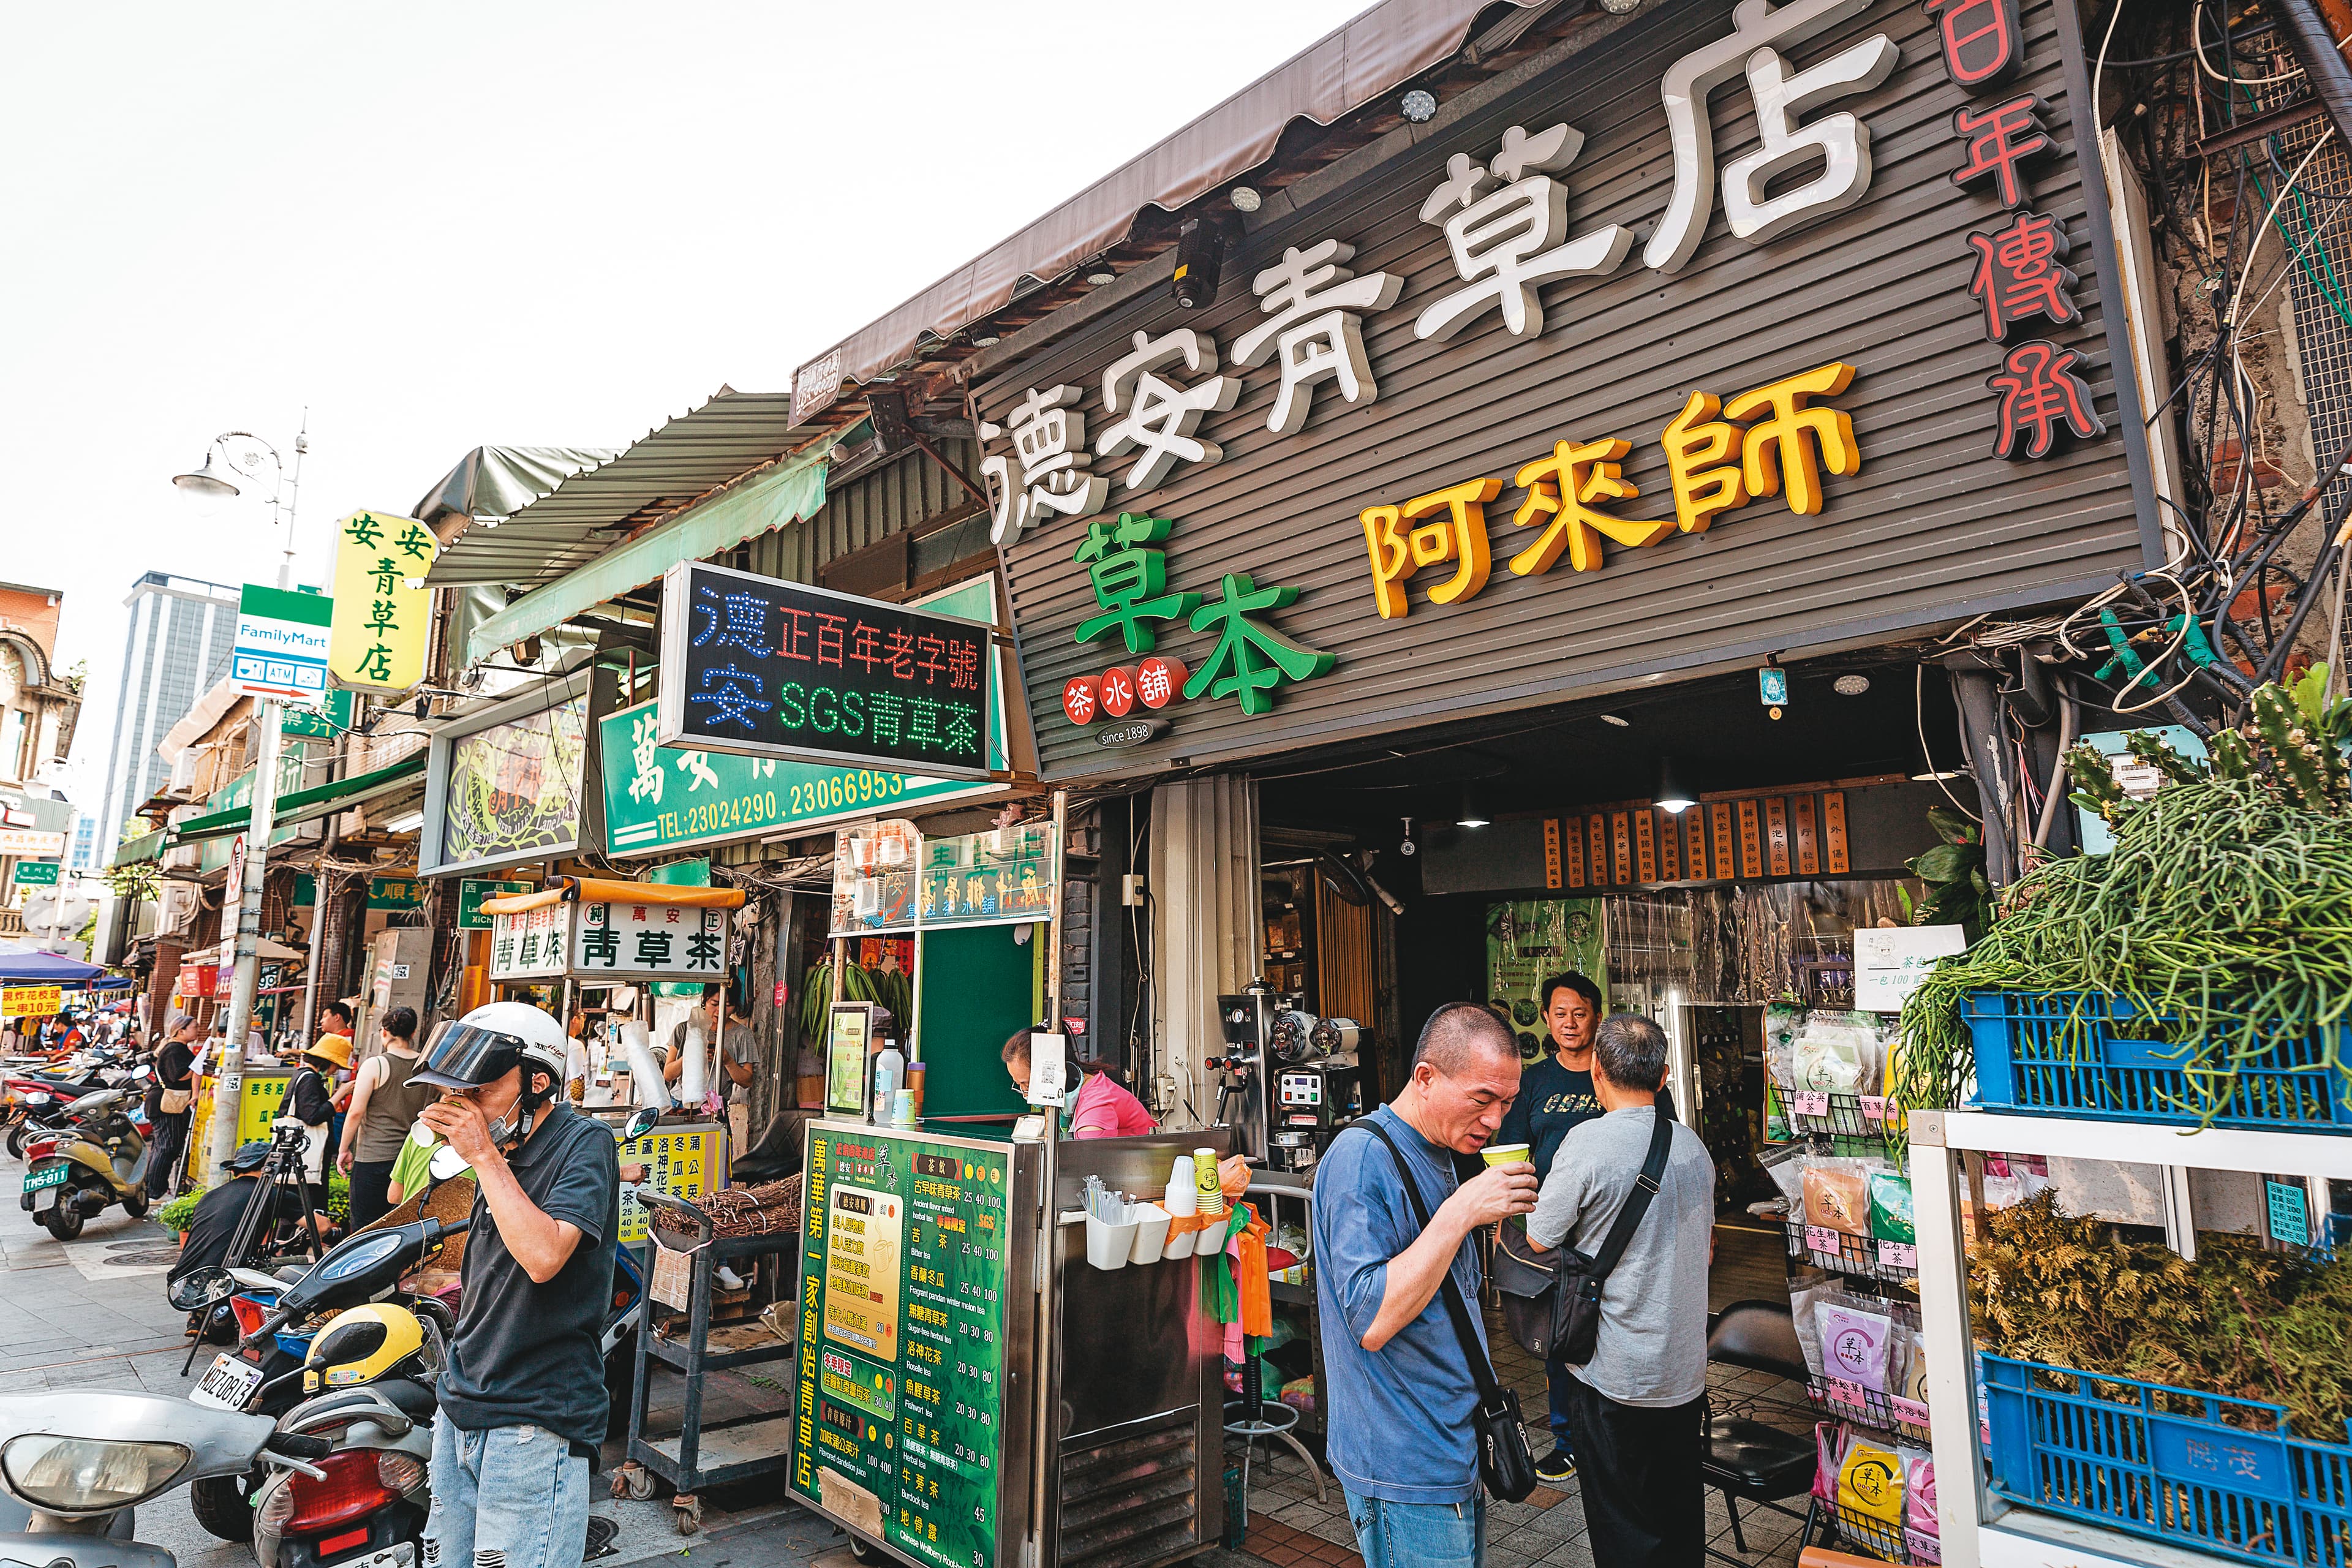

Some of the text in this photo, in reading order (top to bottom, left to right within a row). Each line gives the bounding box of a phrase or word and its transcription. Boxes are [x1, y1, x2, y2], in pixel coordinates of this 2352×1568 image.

[1923, 0, 2098, 457] 百年傳承
[979, 0, 1900, 545] 德安青草店
[1360, 361, 1861, 617] 阿來師
[355, 557, 405, 681] 青草店
[1073, 512, 1335, 715] 草本
[241, 624, 326, 647] FamilyMart
[691, 585, 774, 729] 德安
[776, 606, 978, 691] 正百年老字號
[270, 668, 291, 679] ATM
[779, 681, 978, 755] SGS青草茶
[1102, 725, 1148, 745] since 1898
[632, 906, 680, 924] 萬安
[706, 913, 718, 927] 正
[496, 929, 566, 972] 青草茶
[582, 928, 722, 970] 青草茶
[1891, 974, 1909, 985] 100
[2, 989, 60, 1001] 現炸花枝球
[4, 1001, 56, 1013] 一串10元
[1795, 1090, 1825, 1101] 蒲公英
[1806, 1103, 1815, 1114] 茶
[1862, 1101, 1896, 1114] 百草茶
[875, 1144, 898, 1191] 草本
[928, 1158, 946, 1175] 茶飲
[914, 1179, 1001, 1209] 古早味青草茶 25 40 100
[2284, 1188, 2299, 1197] 100
[2286, 1197, 2296, 1205] 80
[912, 1211, 925, 1221] herbal
[913, 1199, 955, 1215] Ancient flavor mixed
[2286, 1205, 2302, 1214] 100
[978, 1213, 994, 1229] SGS
[2288, 1215, 2302, 1223] 100
[620, 1229, 631, 1237] 100
[1805, 1226, 1838, 1241] 花生根
[2296, 1233, 2306, 1242] 80
[911, 1246, 923, 1257] Bitter
[962, 1242, 971, 1254] 25
[973, 1245, 982, 1257] 40
[985, 1248, 998, 1262] 100
[1818, 1239, 1828, 1251] 茶
[1891, 1253, 1903, 1265] 茶
[910, 1264, 997, 1302] 香蘭冬瓜 25 40 100
[909, 1284, 986, 1315] Fragrant pandan winter melon tea
[797, 1138, 827, 1490] 萬華第一家創始青草店
[908, 1302, 993, 1343] 無糖青草茶 20 30 80
[876, 1322, 884, 1333] 80
[907, 1322, 930, 1337] Sugar-free
[930, 1330, 944, 1342] herbal
[907, 1339, 992, 1384] 洛神花茶 20 30 80
[1841, 1336, 1865, 1366] 草本
[823, 1352, 852, 1378] 冬季限定
[906, 1360, 932, 1378] Roselle tea
[874, 1396, 892, 1412] 30 40
[904, 1399, 924, 1415] Fishwort
[905, 1378, 990, 1426] 魚腥草茶 20 30 80
[1841, 1391, 1852, 1403] 茶
[827, 1406, 852, 1430] 青草原汁
[1892, 1401, 1929, 1422] 沐浴包
[819, 1427, 859, 1460] 加味蒲公英汁
[904, 1416, 989, 1469] 百草茶 20 30 80
[818, 1446, 867, 1478] Flavored dandelion juice
[867, 1453, 892, 1475] 100 400
[903, 1451, 918, 1466] Herbal
[1858, 1468, 1883, 1498] 草本
[901, 1488, 930, 1510] Burdock tea
[902, 1466, 986, 1523] 牛蒡茶 45
[899, 1529, 943, 1563] Chinese Wolfberry
[900, 1507, 984, 1568] 地骨露 30
